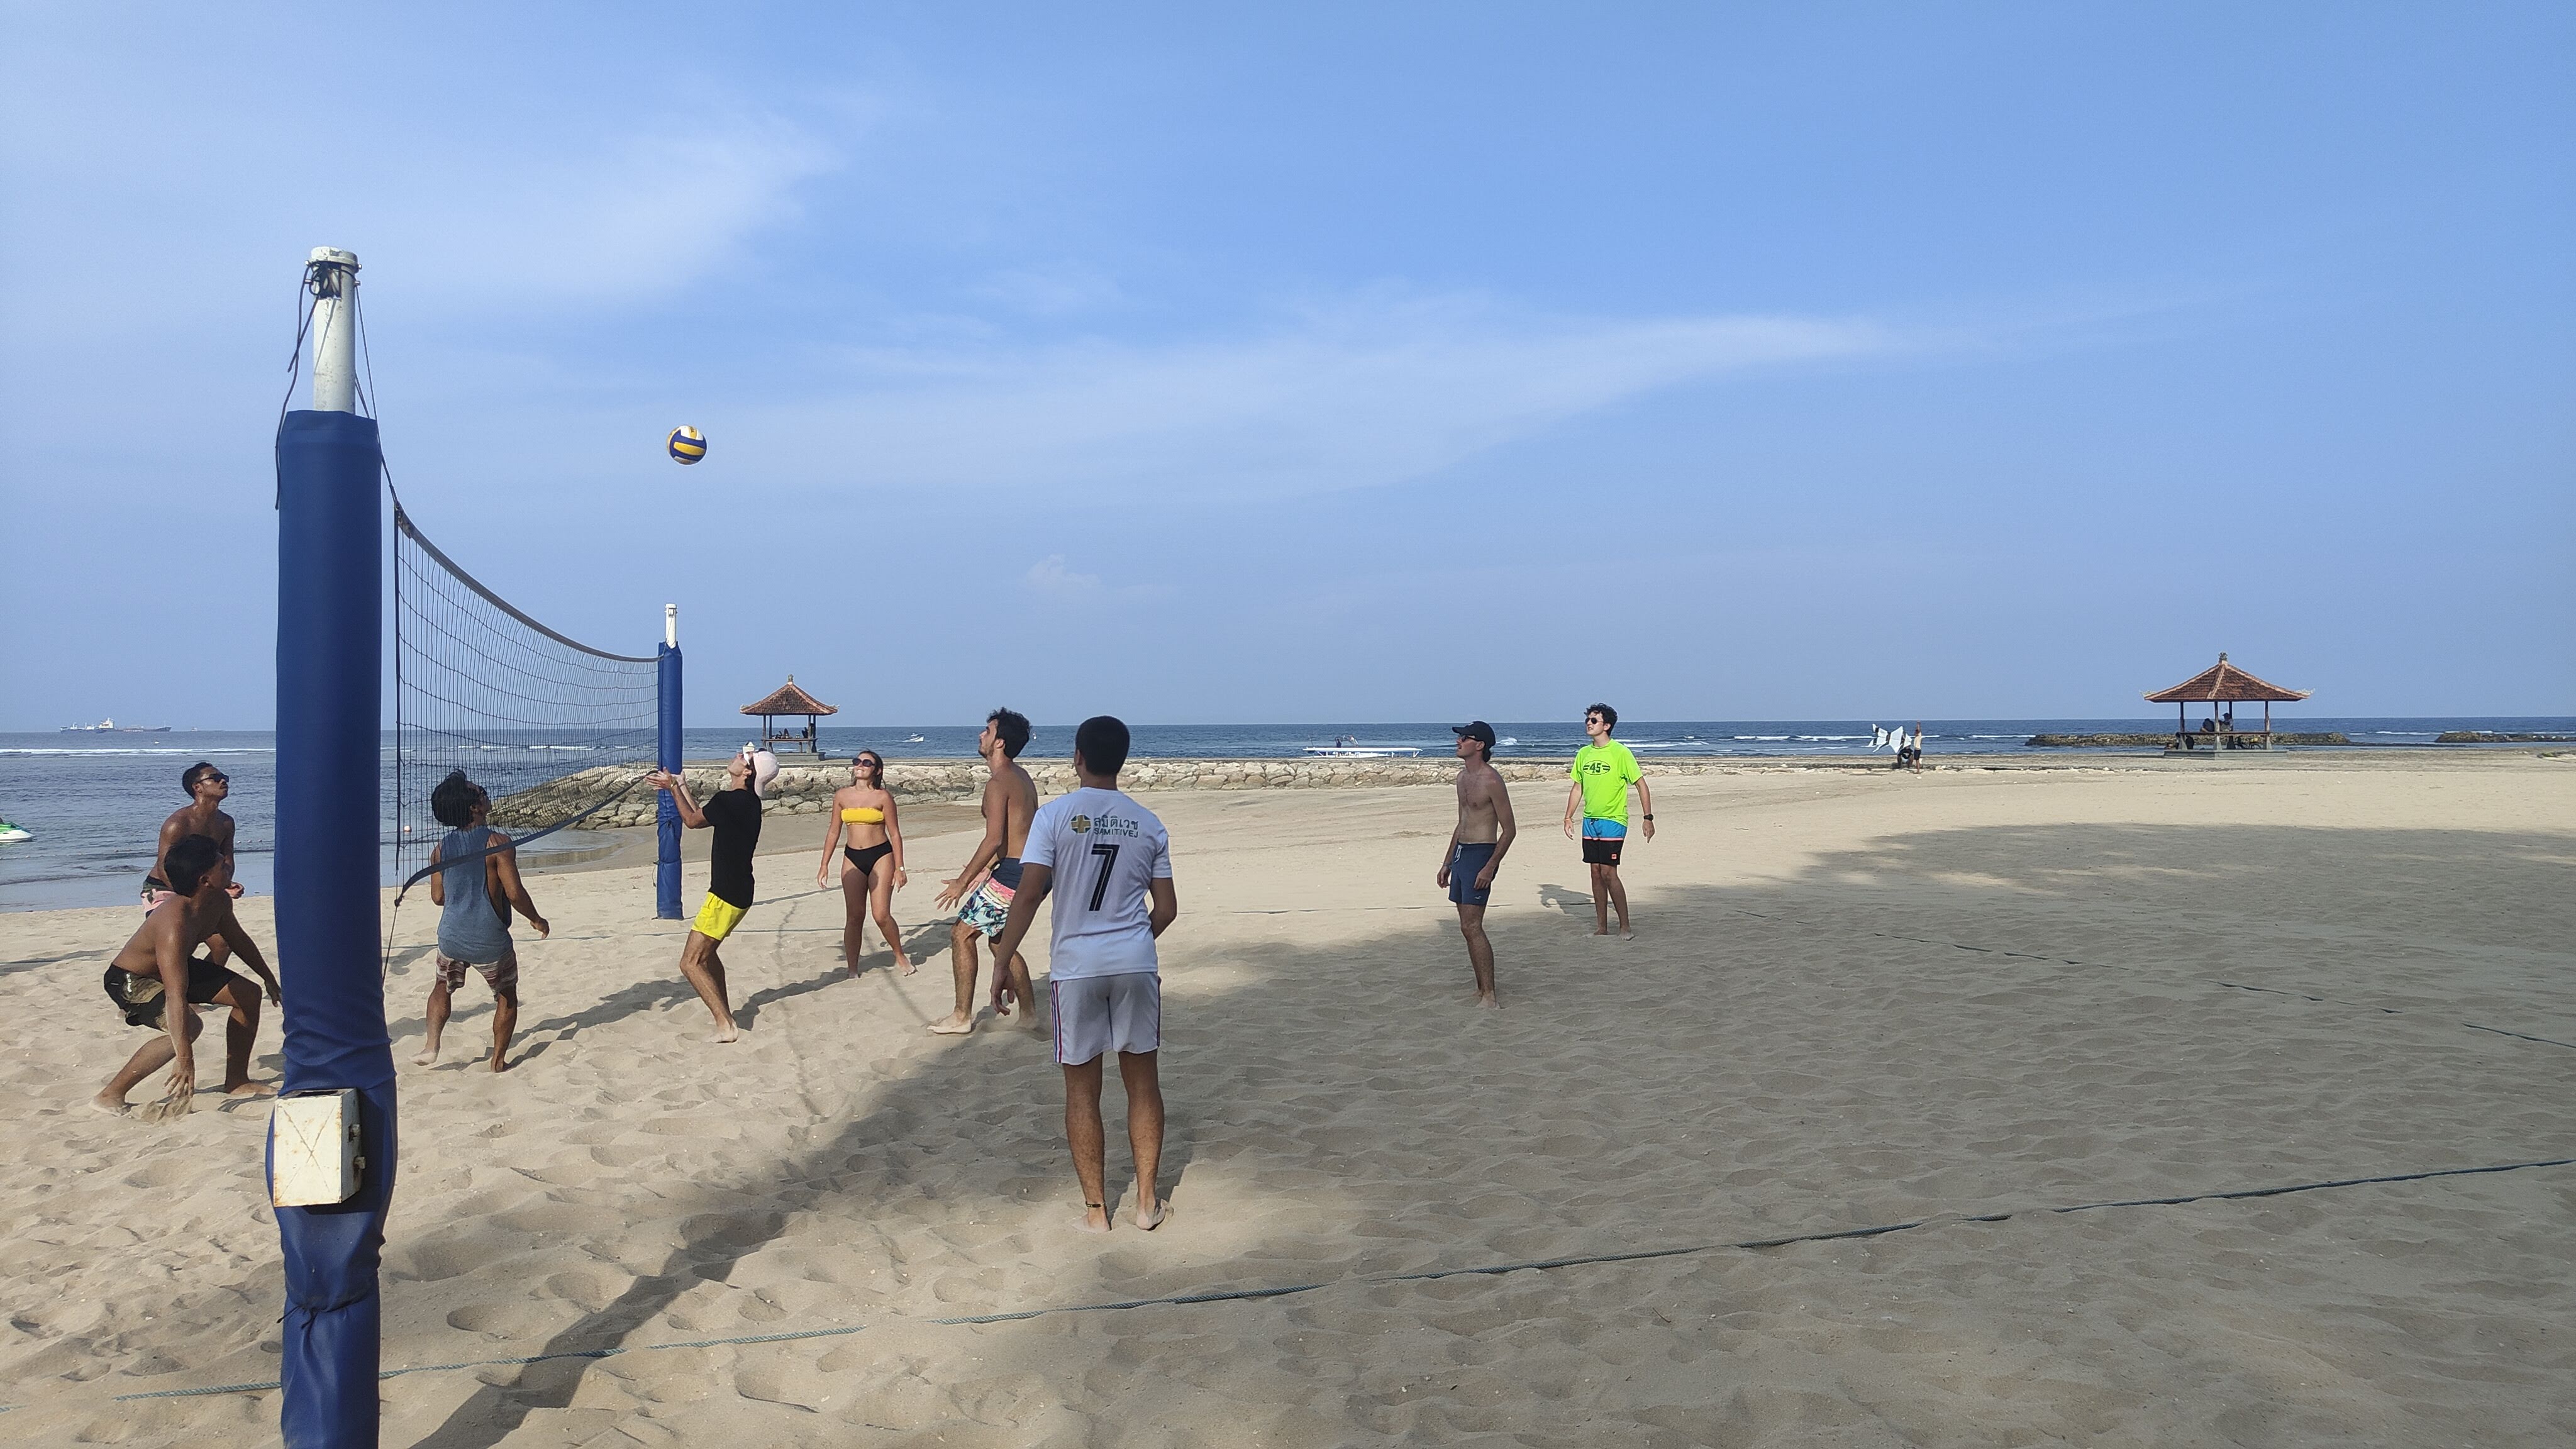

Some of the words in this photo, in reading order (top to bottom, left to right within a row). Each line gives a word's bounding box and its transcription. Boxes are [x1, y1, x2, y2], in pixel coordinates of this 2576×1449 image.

[1589, 762, 1602, 774] 45
[1094, 814, 1138, 830] สมิติเวช
[1094, 828, 1138, 838] SAMITIVEJ
[1089, 843, 1120, 911] 7
